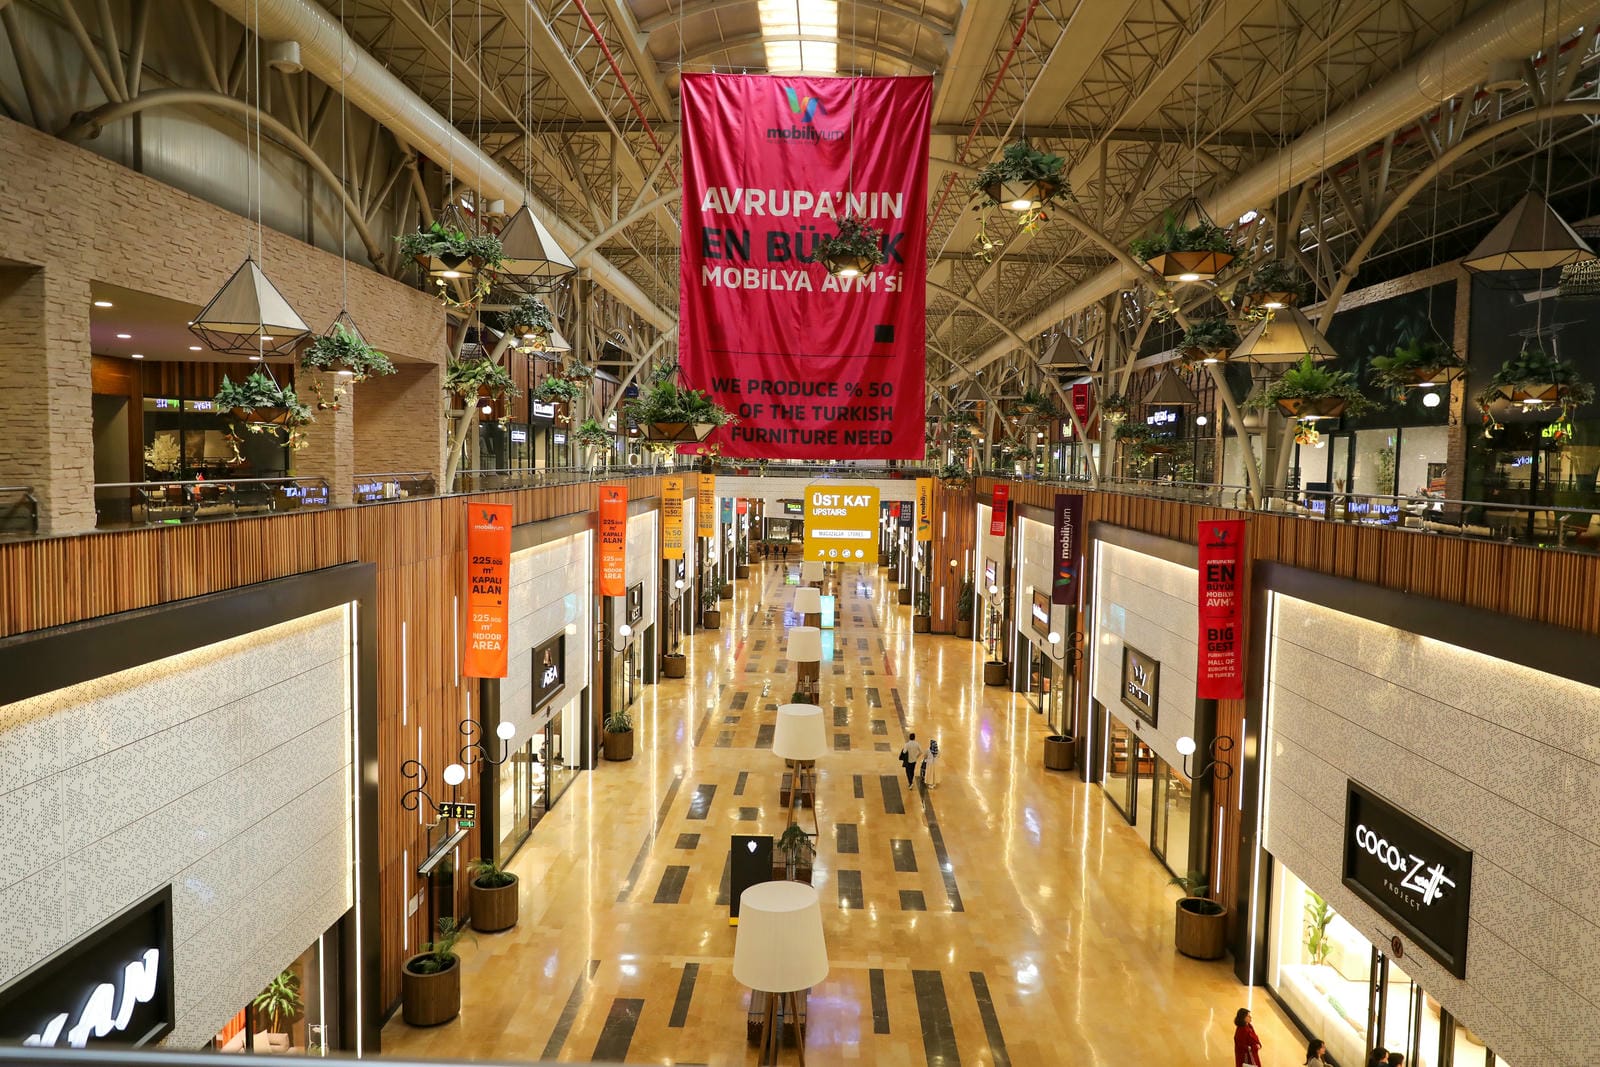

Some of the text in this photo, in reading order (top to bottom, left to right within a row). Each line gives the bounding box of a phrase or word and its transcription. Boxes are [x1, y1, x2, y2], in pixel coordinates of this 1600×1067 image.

[766, 124, 845, 145] mobiliyum
[701, 186, 903, 219] AVRUPA'NIN
[702, 225, 905, 265] EN BÜK
[711, 377, 893, 398] WE PRODUCE % 50
[738, 403, 893, 421] OF THE TURKISH
[731, 426, 893, 445] FURNITURE NEED
[812, 492, 871, 507] ÜST KAT
[812, 508, 848, 517] UPSTAIRS
[1060, 508, 1073, 559] mobiliyum
[472, 576, 502, 584] KAPALI
[1207, 564, 1236, 582] EN
[472, 585, 502, 594] ALAN
[472, 632, 502, 640] INDOOR
[1207, 627, 1234, 641] BIG
[472, 640, 501, 651] AREA
[1207, 641, 1234, 652] GEST
[1355, 823, 1401, 872] COCO
[1383, 878, 1421, 912] PROJECT
